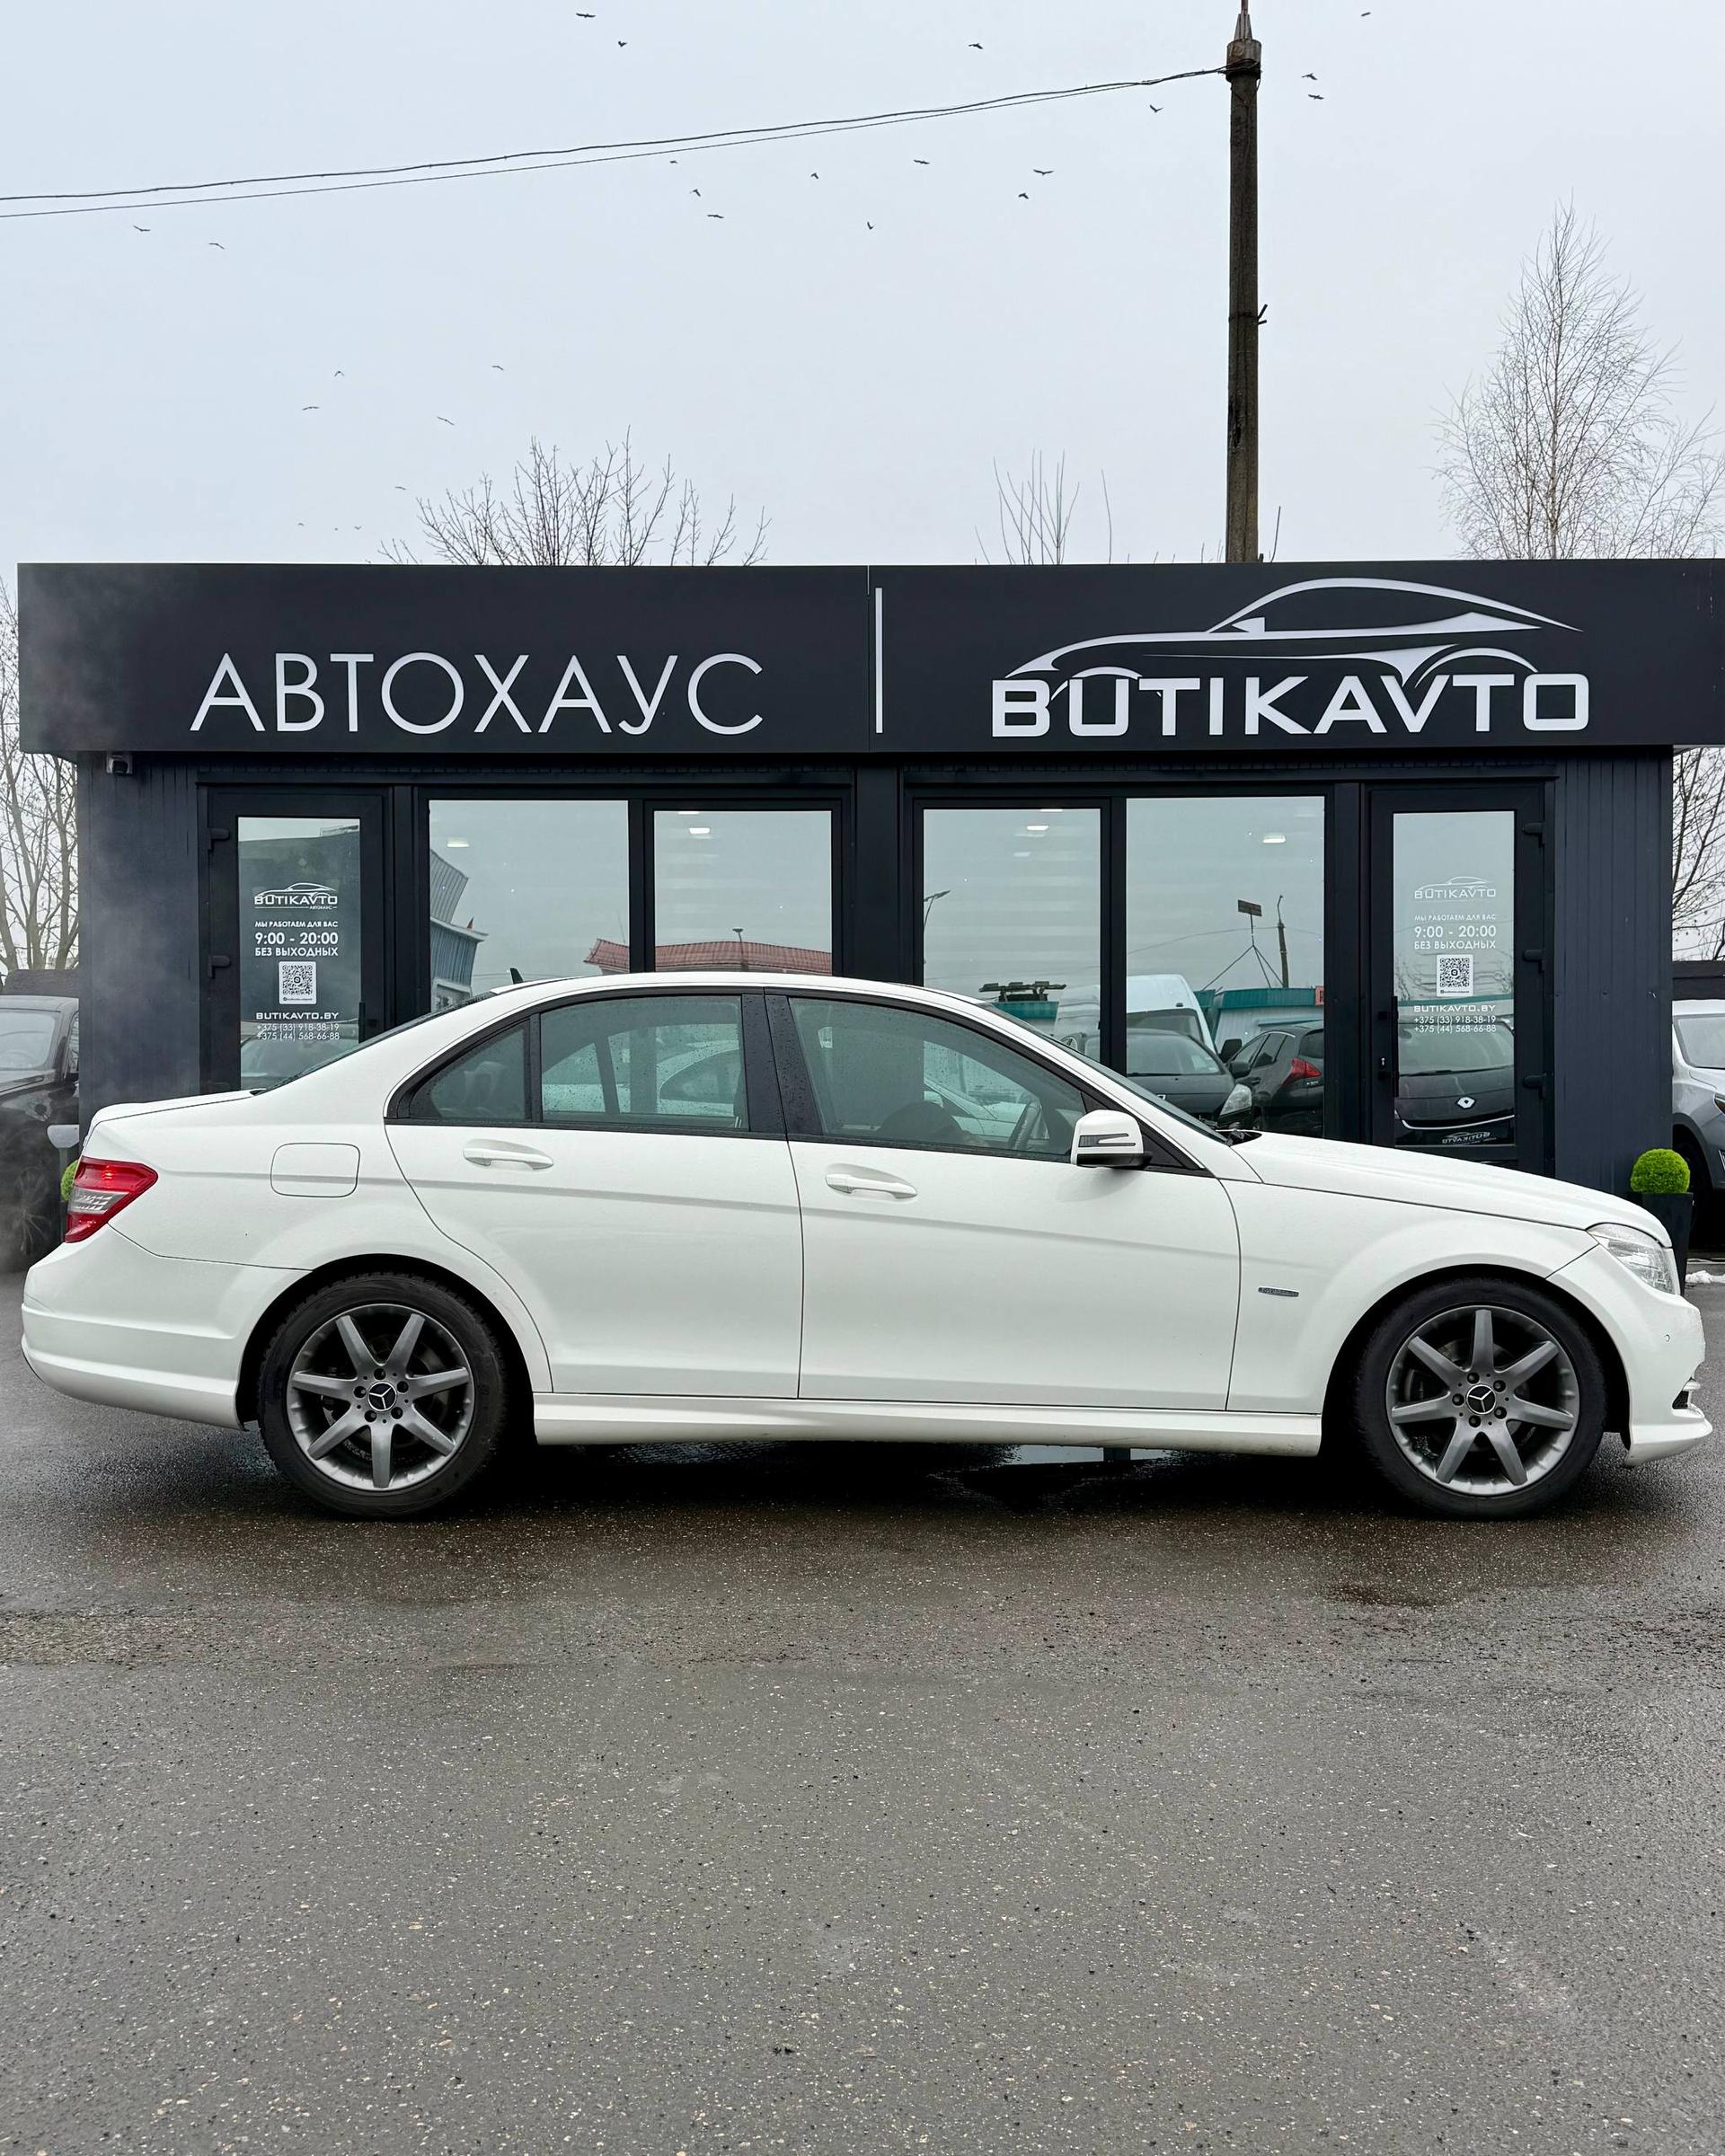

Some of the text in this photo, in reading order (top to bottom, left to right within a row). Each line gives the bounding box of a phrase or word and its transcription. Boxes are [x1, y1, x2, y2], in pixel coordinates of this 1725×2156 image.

[190, 652, 764, 736] АВТОХАУС
[992, 672, 1589, 738] BUTIKAVTO
[1414, 888, 1496, 898] BUTIKAVTO
[254, 896, 338, 905] BUTIKAVTO
[1429, 914, 1465, 922] РАБОТАЕМ
[1414, 925, 1444, 938] 9:00
[1458, 925, 1496, 937] 20:00
[255, 932, 285, 944] 9:00
[299, 932, 339, 944] 20:00
[1414, 940, 1496, 950] БЕЗ ВЫХОДНЫХ
[255, 947, 339, 958] БЕЗ ВЫХОДНЫХ
[1413, 1004, 1496, 1012] BUTIKAVTO.BY
[255, 1012, 339, 1020] BUTIKAVTO.BY
[1413, 1015, 1497, 1025] +375 (33) 918-38-19
[257, 1023, 340, 1033] +375 (33) 918-38-19
[1413, 1024, 1497, 1034] +375 (44) 568-66-88
[257, 1032, 340, 1042] +375 (44) 568-66-88
